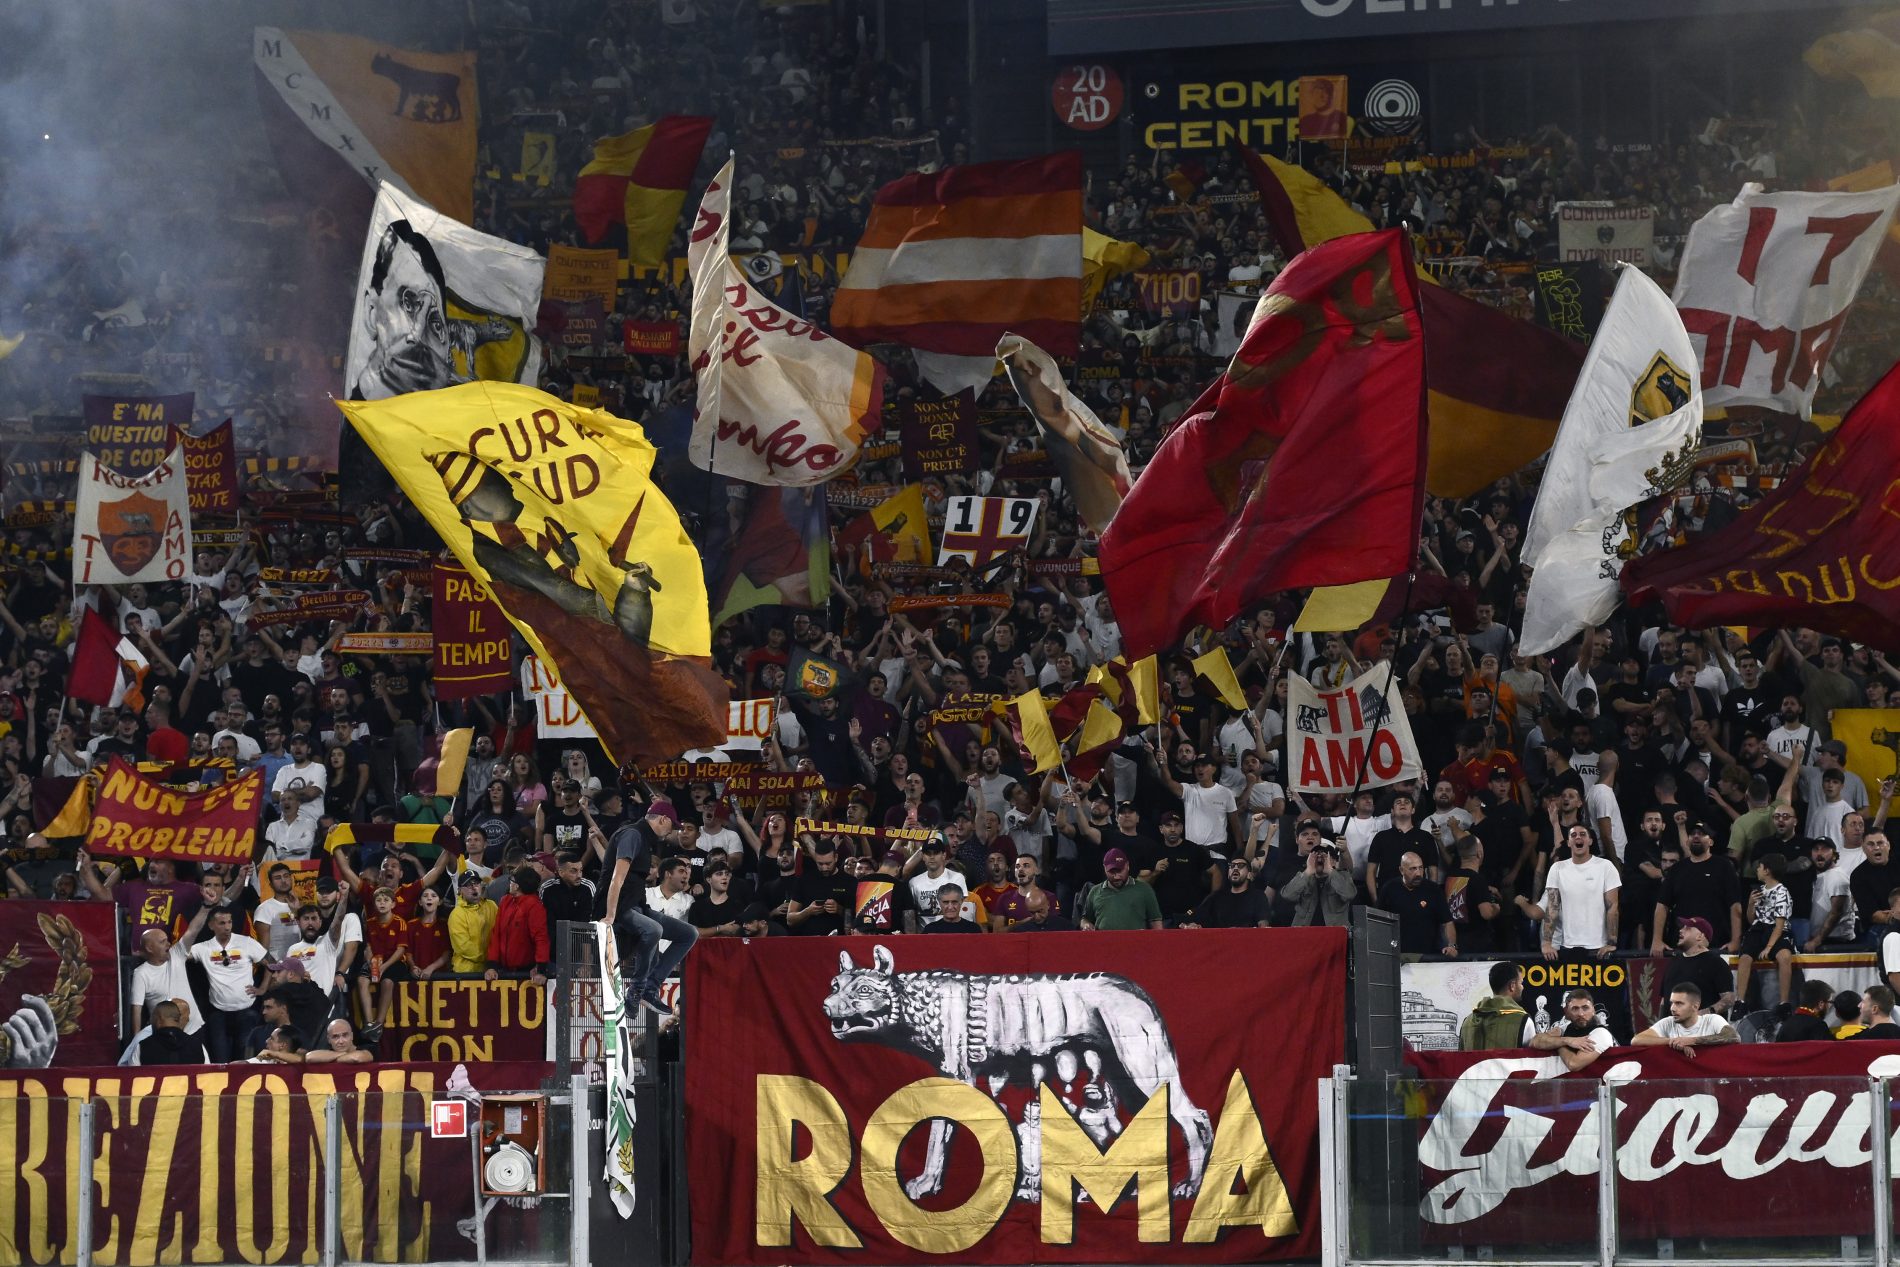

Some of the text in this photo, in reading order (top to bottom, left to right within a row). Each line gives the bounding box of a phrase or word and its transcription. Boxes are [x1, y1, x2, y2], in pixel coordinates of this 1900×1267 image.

[1071, 65, 1107, 93] 20
[1067, 95, 1110, 124] AD
[914, 402, 940, 413] NON
[918, 412, 960, 424] DONNA
[100, 449, 123, 467] DE
[917, 450, 943, 461] NON
[922, 460, 964, 472] PRETE
[213, 491, 230, 507] TE
[165, 509, 186, 580] AMO
[291, 568, 330, 583] 1927
[1035, 563, 1081, 573] OVUNQUE
[468, 611, 486, 632] IL
[439, 640, 510, 666] TEMPO
[1318, 687, 1365, 735] TI
[1300, 727, 1403, 789] AMO
[1575, 763, 1600, 776] VANS
[101, 768, 188, 817] NUN
[758, 775, 795, 790] SOLA
[86, 816, 255, 857] PROBLEMA
[401, 1032, 494, 1062] CON
[756, 1067, 1300, 1254] ROMA
